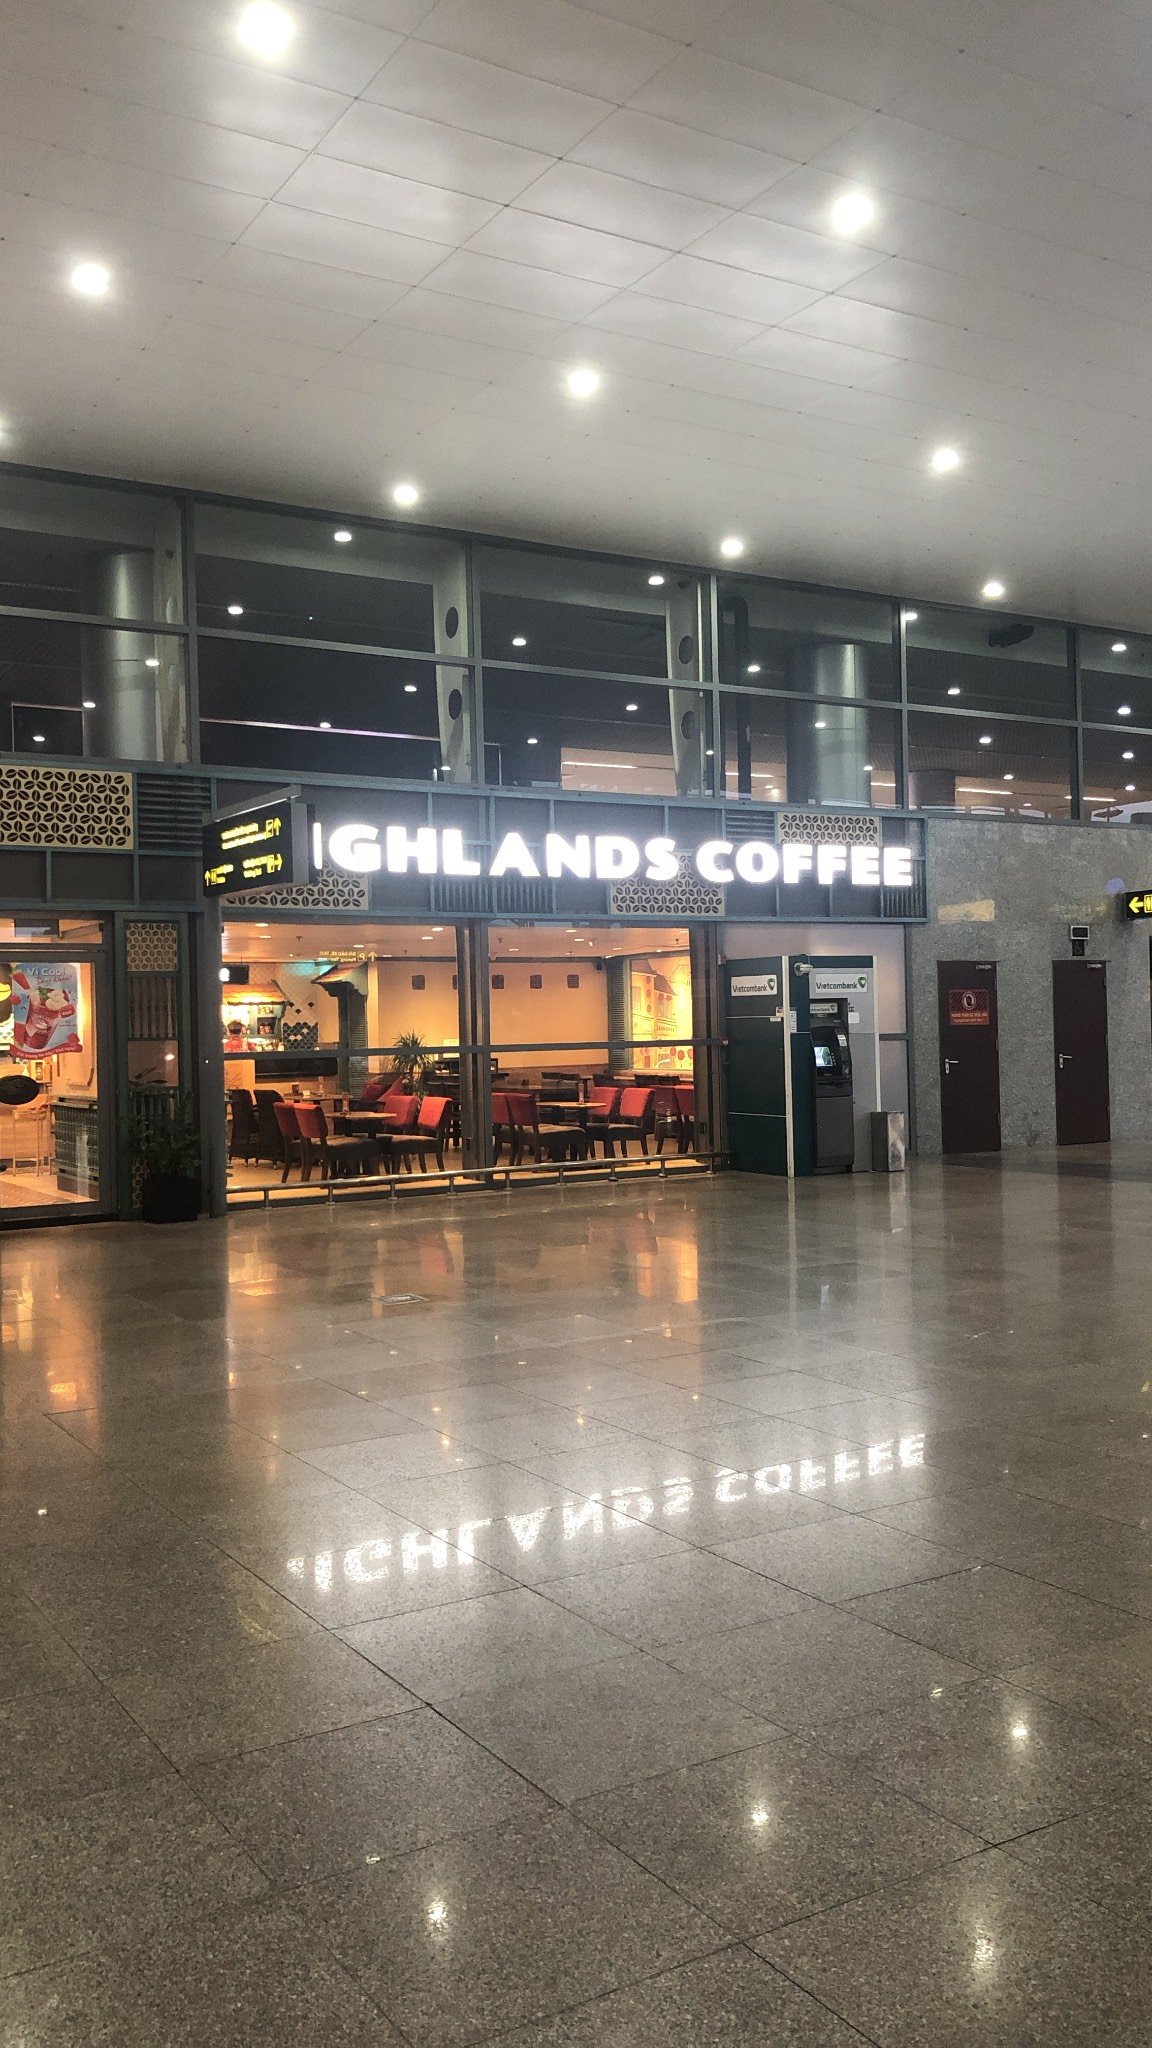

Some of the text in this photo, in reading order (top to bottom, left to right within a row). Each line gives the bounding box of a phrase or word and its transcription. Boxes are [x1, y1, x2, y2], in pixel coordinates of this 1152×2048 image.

[313, 822, 912, 886] IGHLANDS COFFEE
[733, 984, 768, 993] Vietcombank
[816, 981, 858, 990] Vietcombank
